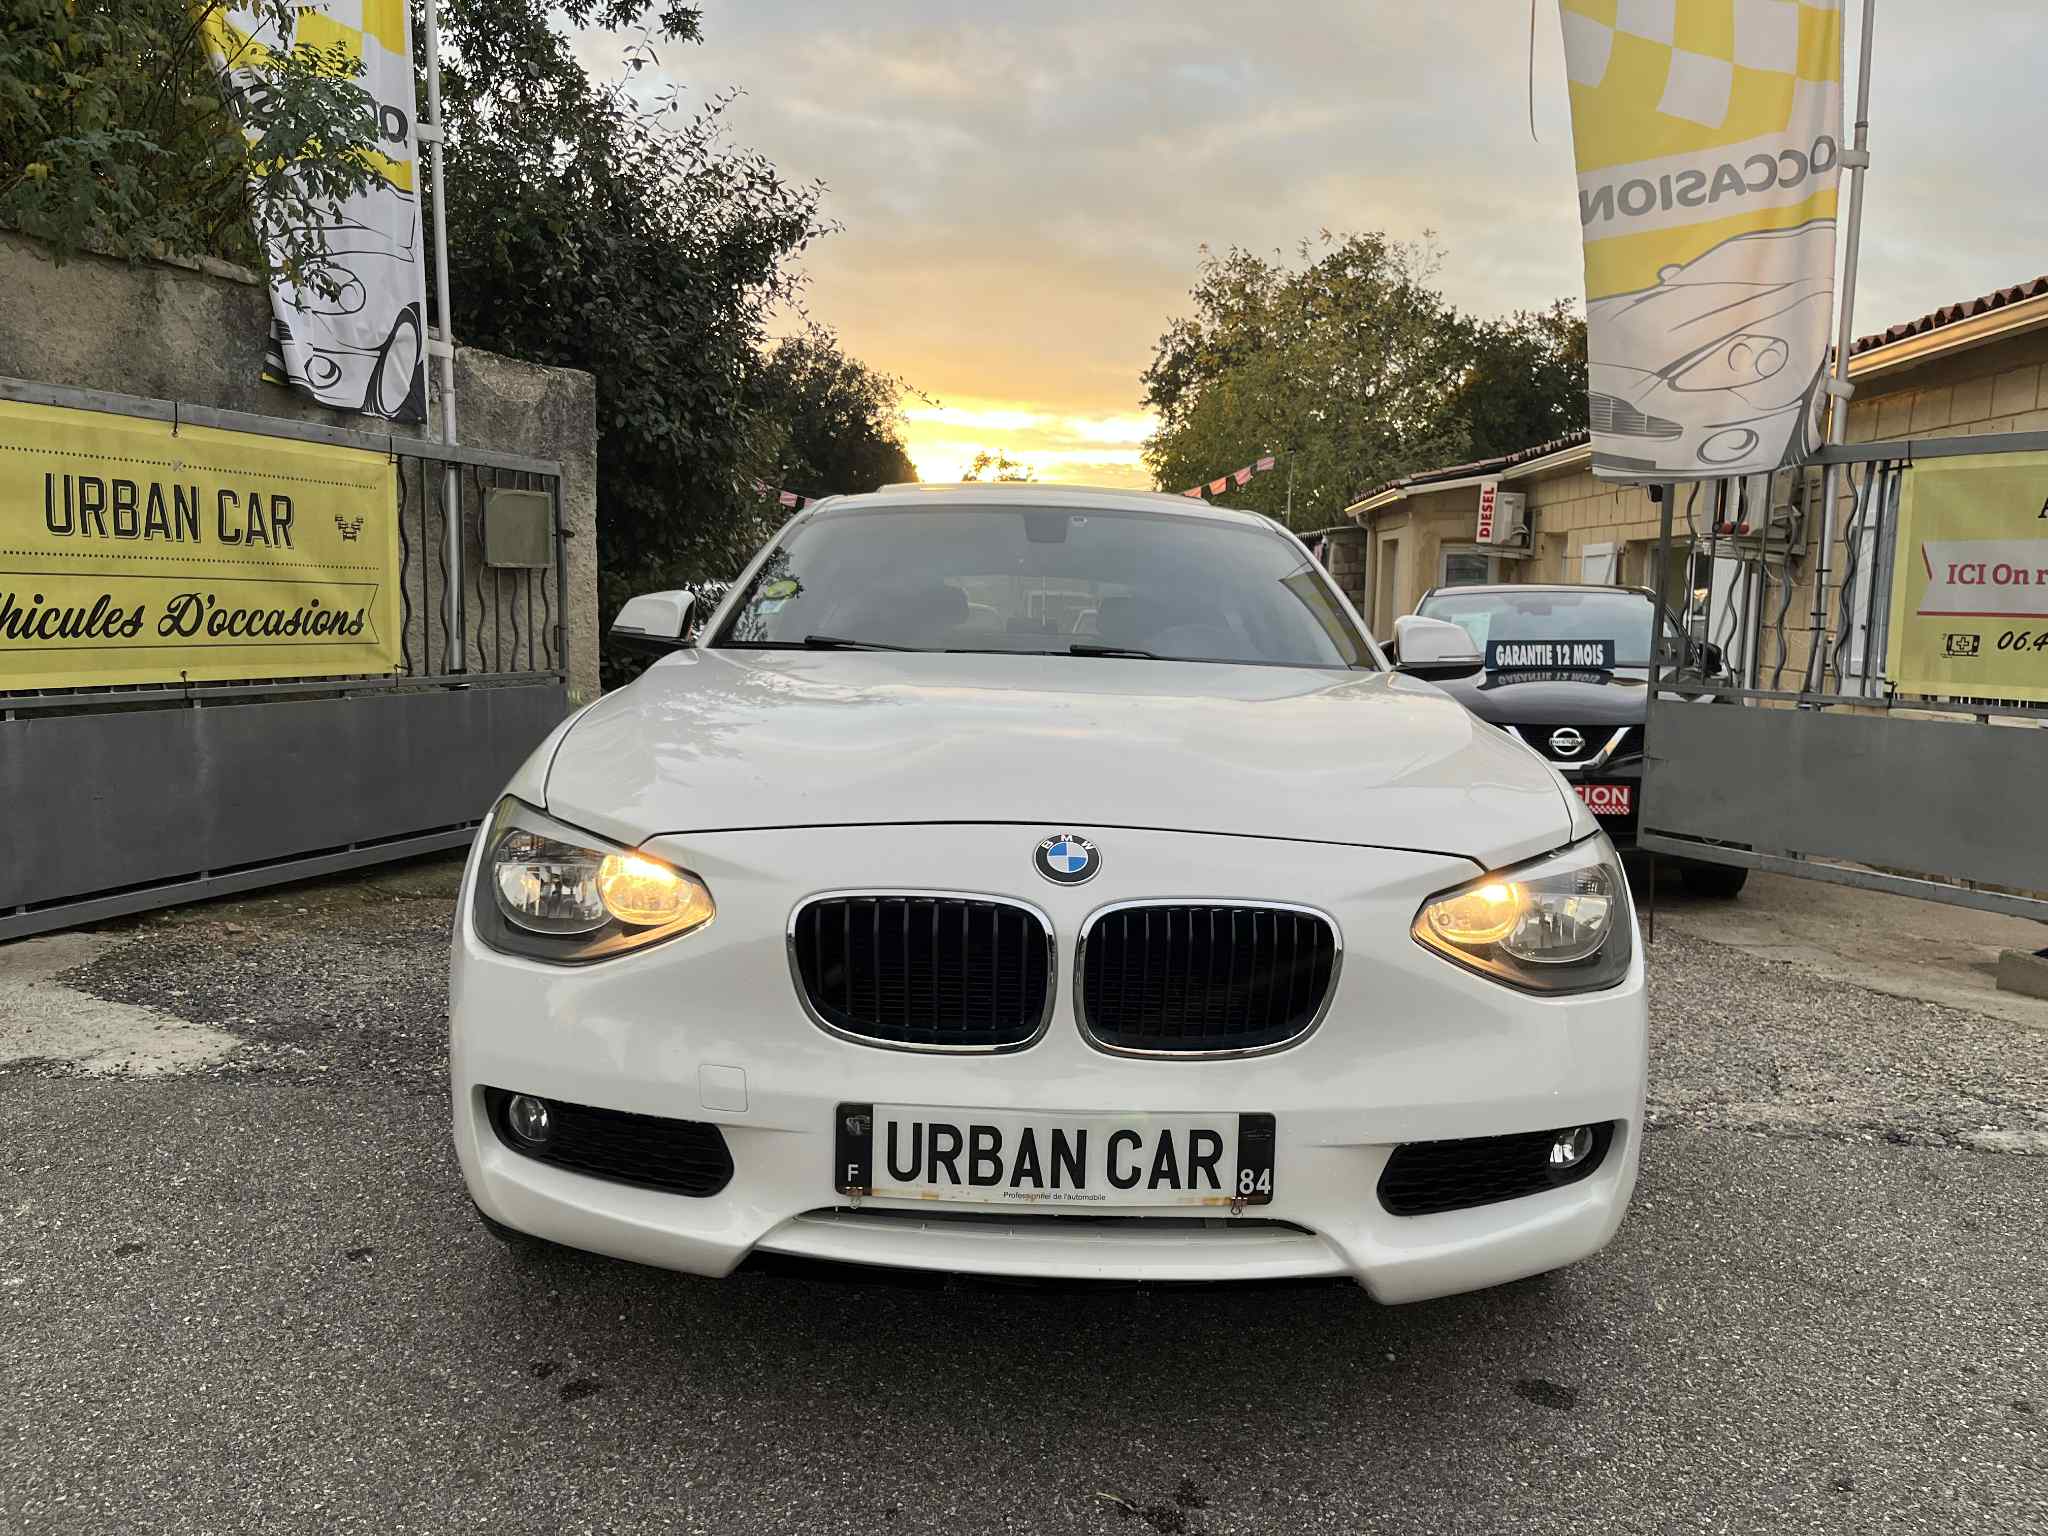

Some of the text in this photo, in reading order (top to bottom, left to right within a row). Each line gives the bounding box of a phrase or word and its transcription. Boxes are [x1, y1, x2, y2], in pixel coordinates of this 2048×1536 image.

[45, 472, 295, 549] URBAN CAR
[1479, 487, 1495, 538] DIESEL
[1946, 563, 1987, 585] ICI
[1992, 563, 2029, 585] On
[0, 592, 365, 640] hicules D'occasions
[1495, 644, 1604, 666] GARANTIE 12 MOIS
[847, 1163, 860, 1182] F
[887, 1121, 1224, 1191] URBAN CAR
[1239, 1168, 1271, 1195] 84
